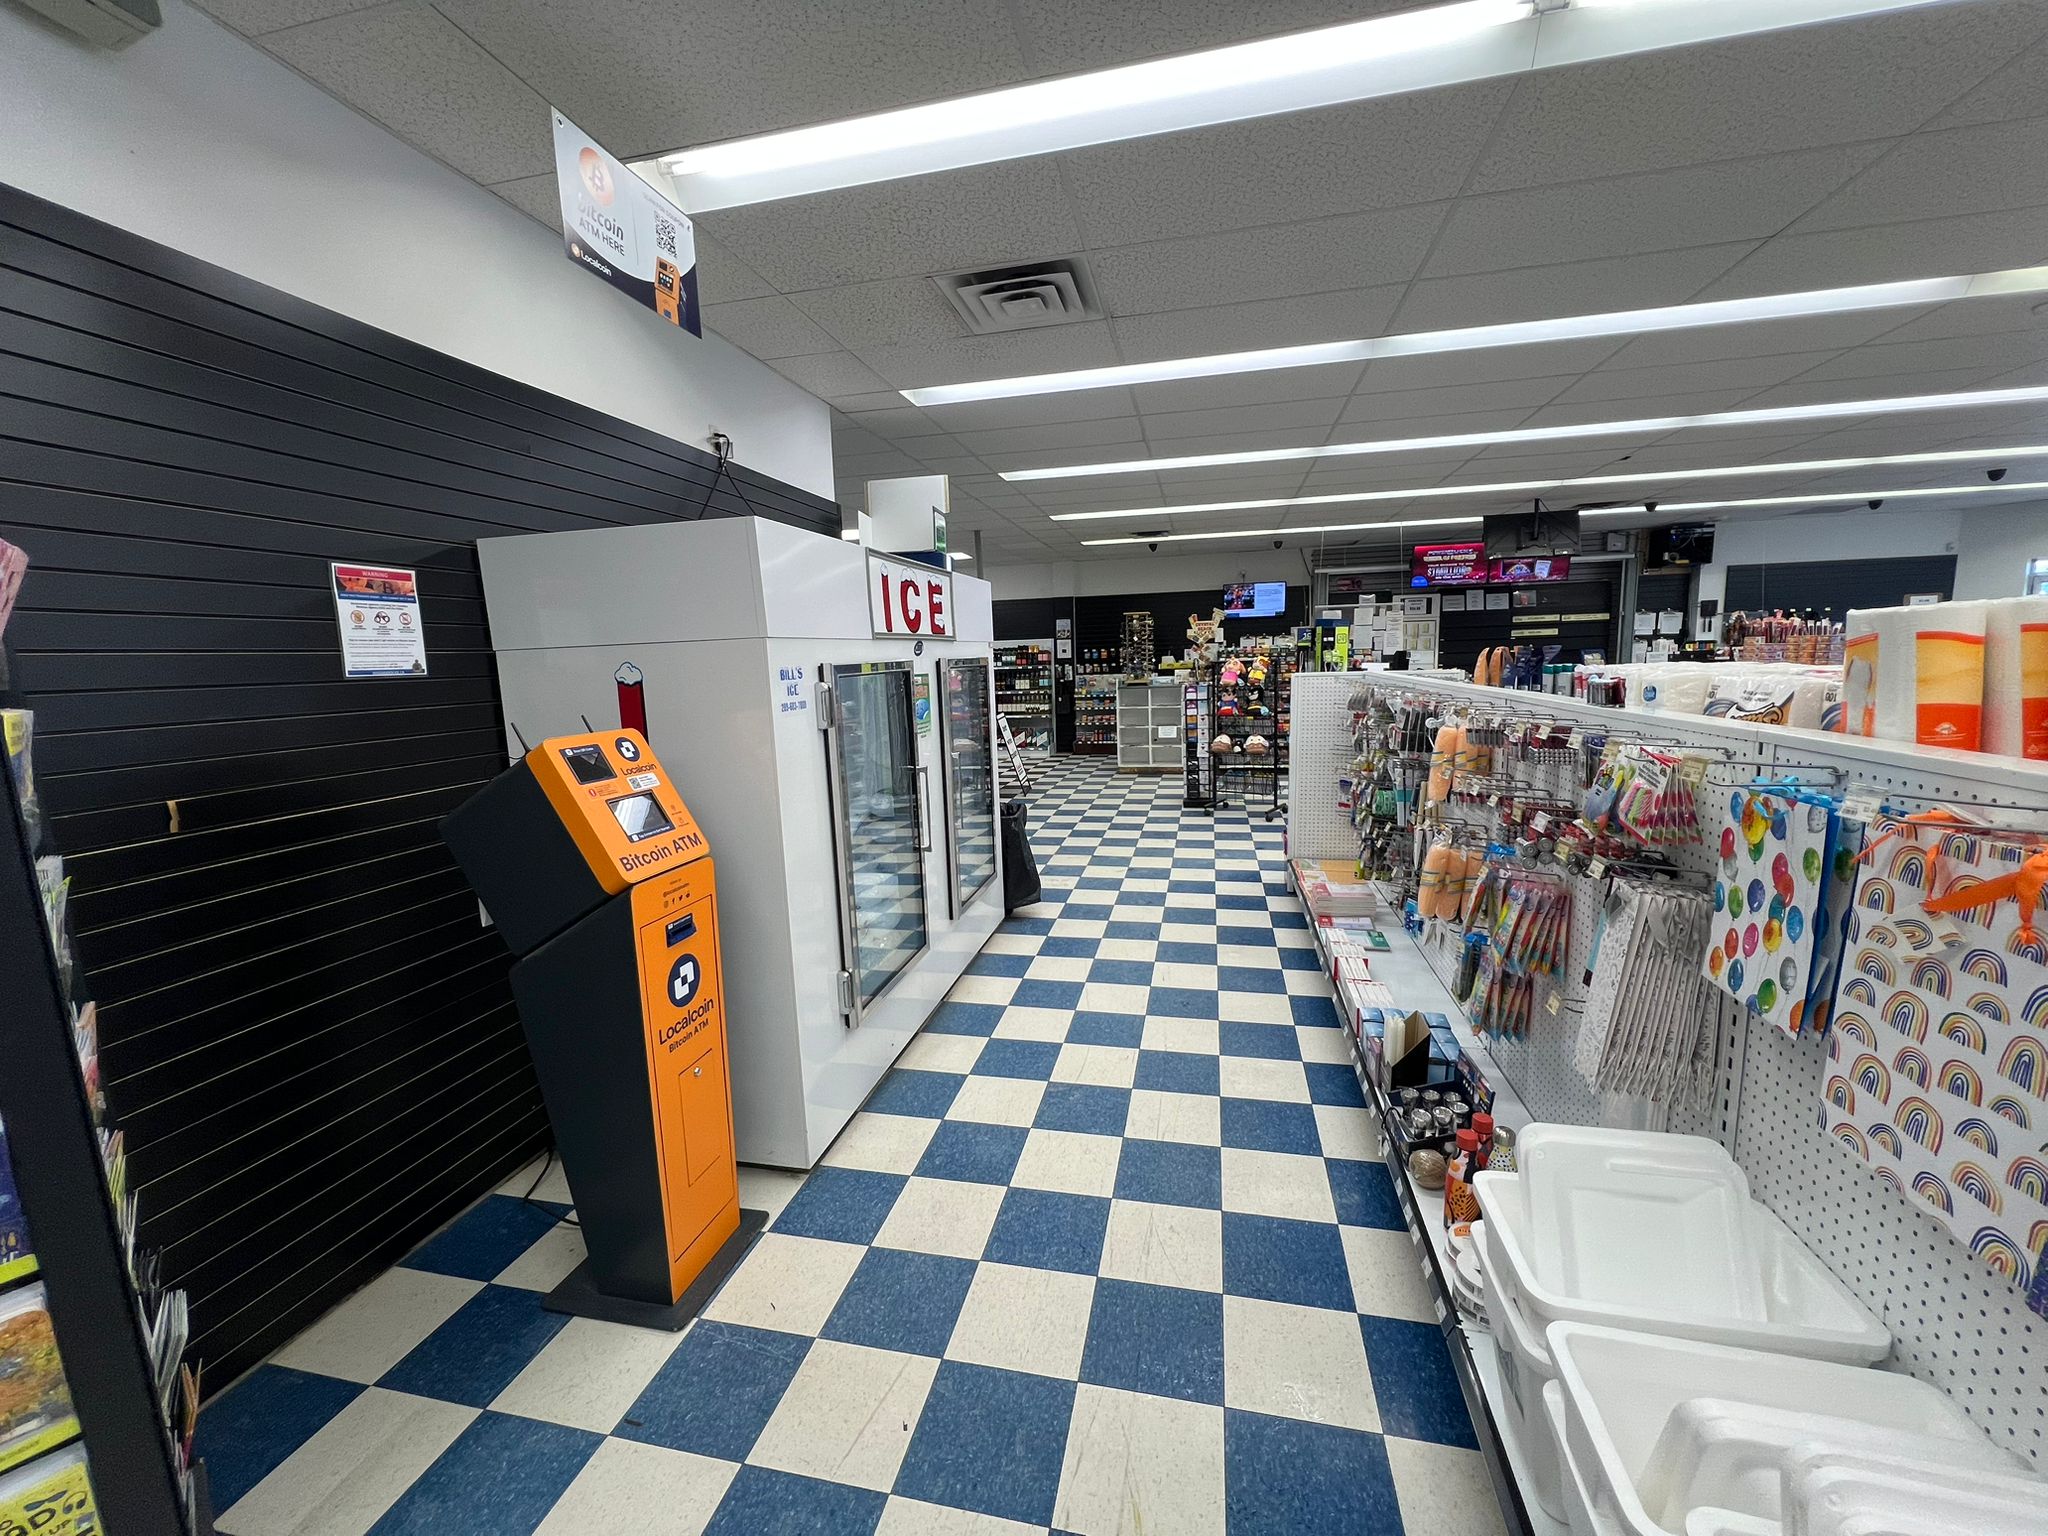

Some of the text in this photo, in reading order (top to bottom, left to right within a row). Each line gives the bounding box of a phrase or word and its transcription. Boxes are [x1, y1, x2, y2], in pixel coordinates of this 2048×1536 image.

[579, 217, 626, 257] ATM HERE
[580, 249, 612, 277] Localcoin
[362, 570, 389, 579] WARNING
[879, 562, 947, 636] ICE
[780, 667, 804, 681] BILL'S
[787, 684, 800, 697] ICE
[620, 762, 657, 776] Localcoin
[618, 832, 703, 872] Bitcoin ATM
[658, 997, 714, 1046] Localcoin
[668, 1018, 709, 1054] Bitcoin ATM
